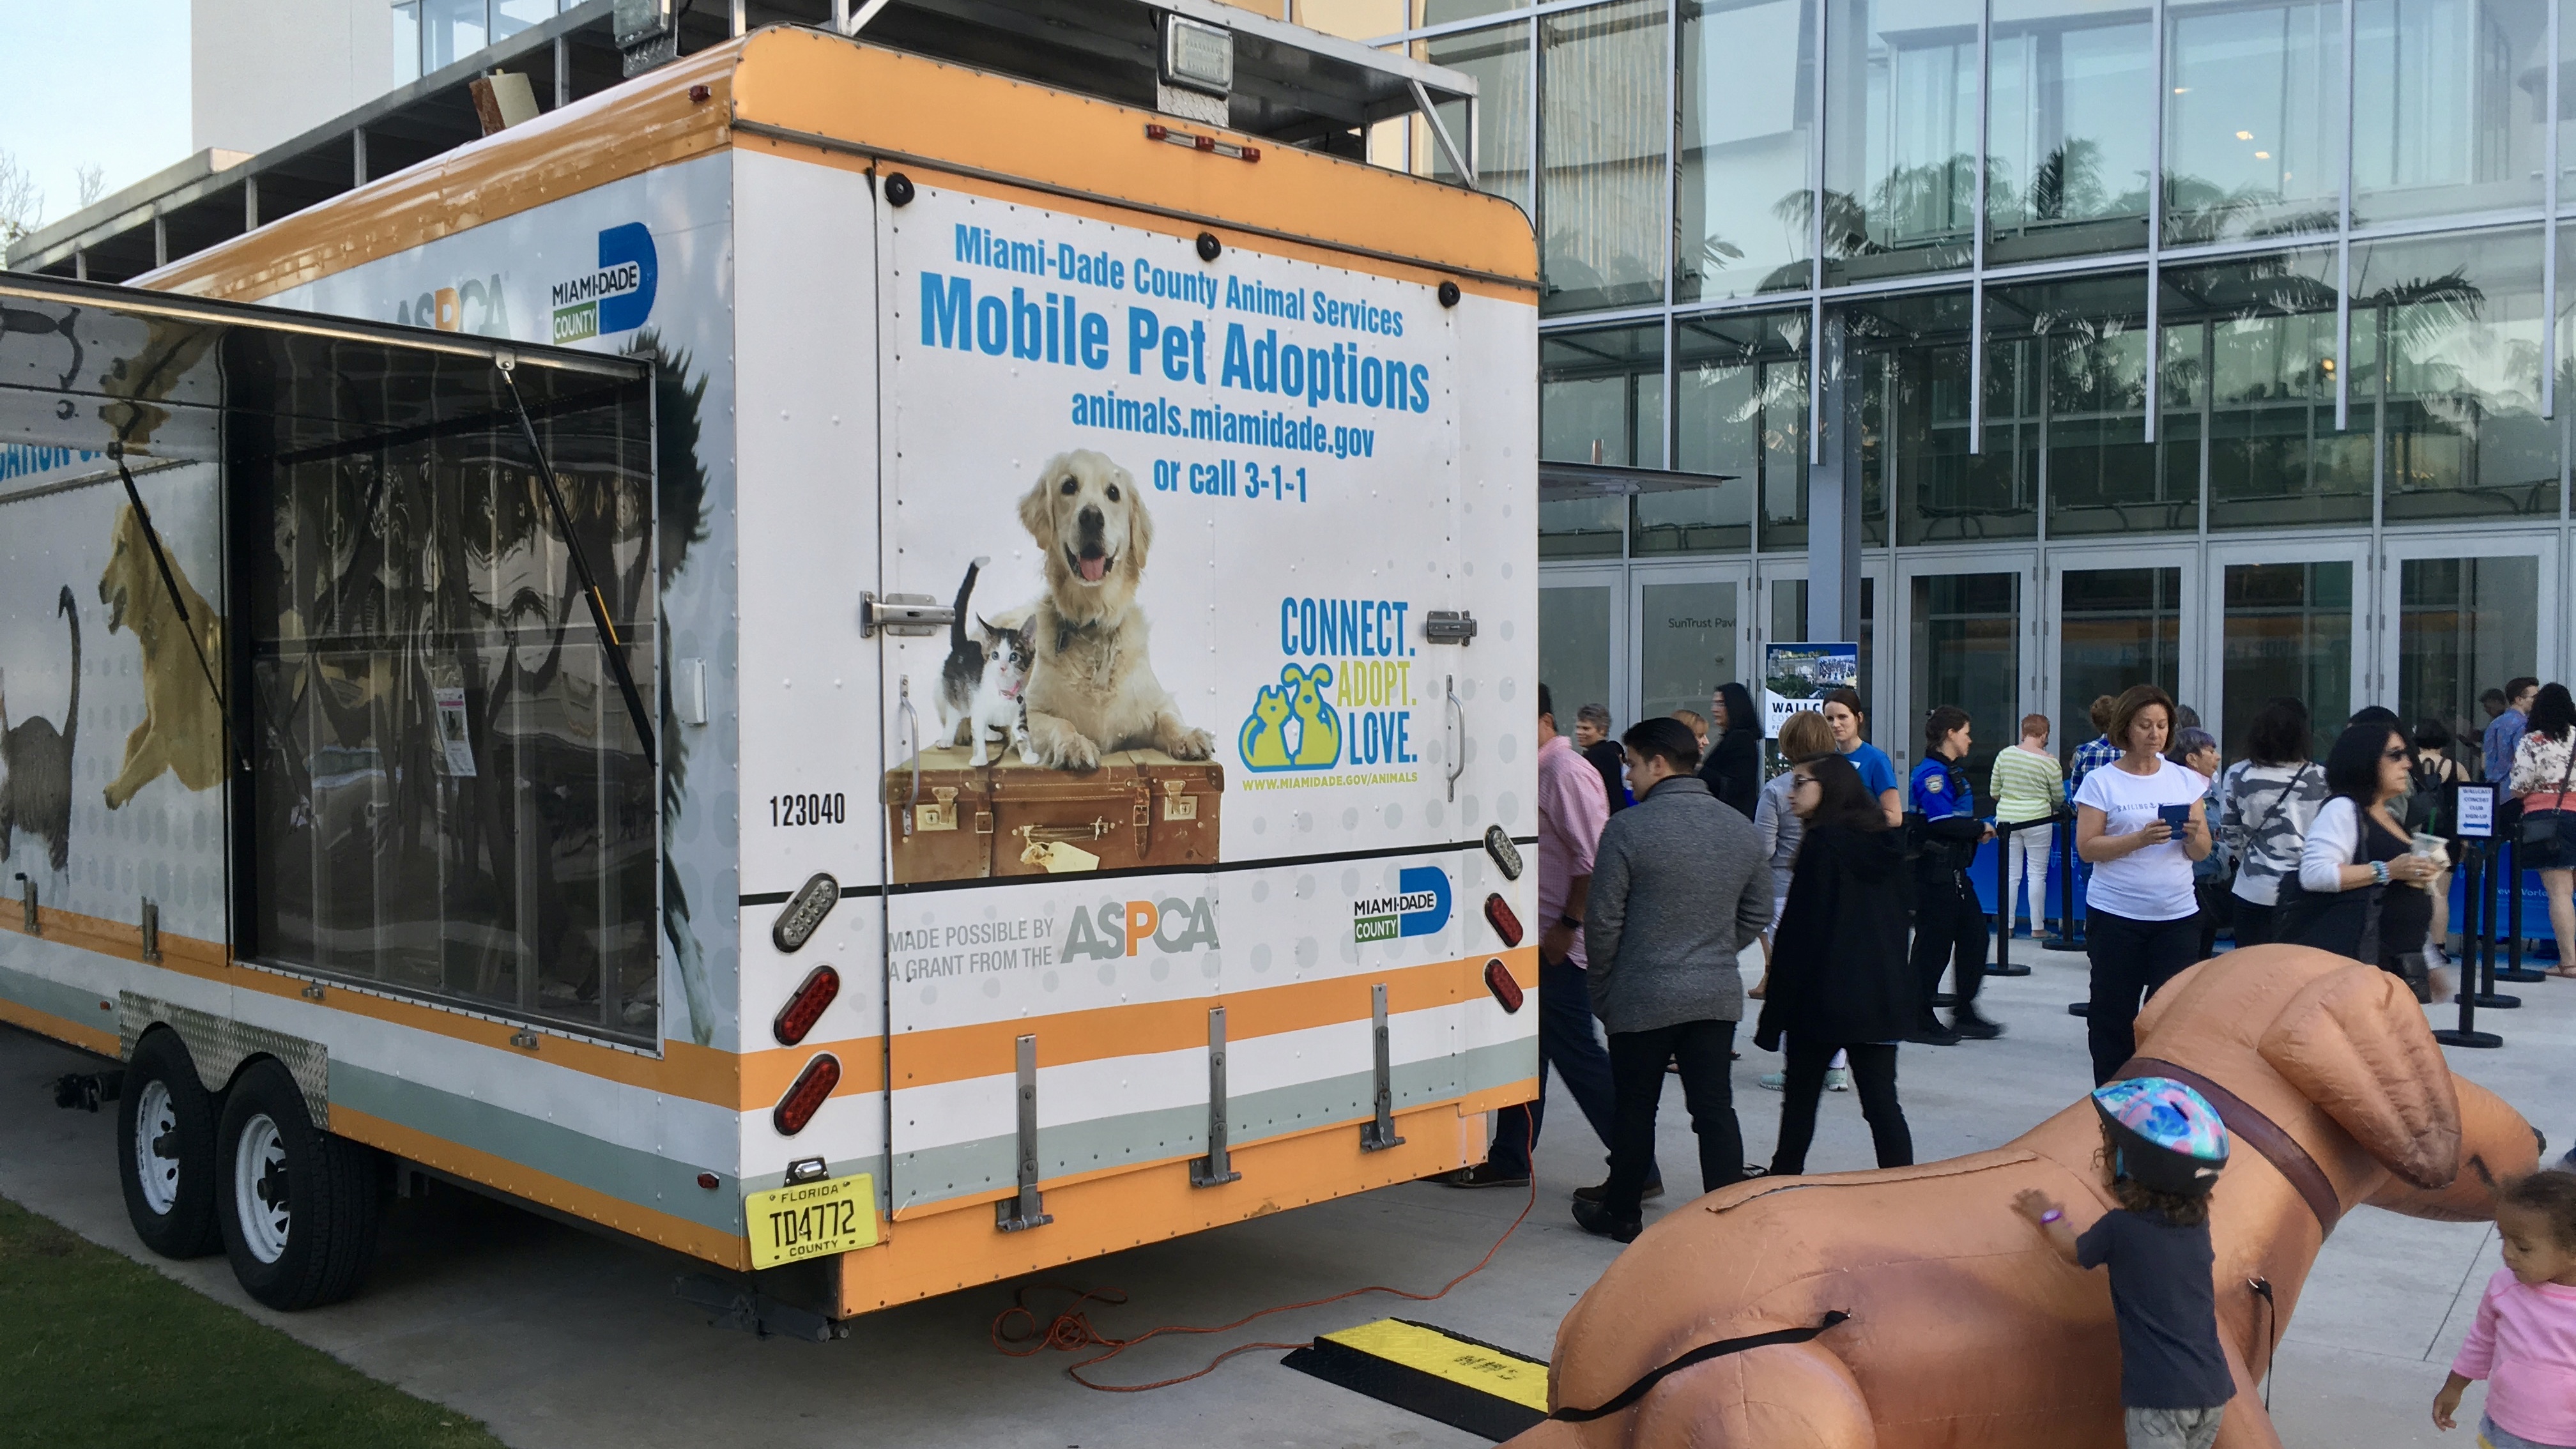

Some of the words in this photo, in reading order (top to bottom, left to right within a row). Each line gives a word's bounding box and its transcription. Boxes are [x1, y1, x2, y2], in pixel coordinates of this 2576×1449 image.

[955, 223, 1124, 290] Miami-Dade
[1134, 257, 1218, 310] County
[1226, 275, 1305, 321] Animal
[1312, 290, 1404, 337] Services
[555, 308, 595, 339] COUNTY
[920, 270, 1109, 371] Mobile
[1129, 305, 1206, 385] Pet
[1221, 321, 1430, 414] Adoptions
[1071, 389, 1374, 459] animals.miamidade.gov
[1154, 459, 1181, 491] or
[1190, 459, 1236, 497] call
[1245, 462, 1307, 503] 3-1-1
[1282, 597, 1416, 657] CONNECT.
[1668, 618, 1712, 628] SunTrust
[1337, 660, 1417, 707] ADOPT.
[1349, 712, 1418, 765] LOVE.
[1243, 771, 1418, 791] WWW.MIAMIDADE.GOV/ANIMALS
[770, 792, 845, 827] 123040
[2117, 803, 2149, 812] SAILING
[888, 928, 939, 953] MADE
[946, 920, 1028, 947] POSSIBLE
[1034, 917, 1054, 939] BY
[1061, 896, 1222, 964] ASPCA
[1356, 919, 1397, 939] COUNTY
[889, 961, 900, 981] A
[906, 954, 964, 980] GRANT
[970, 949, 1017, 973] FROM
[1022, 946, 1052, 967] THE
[781, 1184, 839, 1203] FLORIDA
[769, 1199, 856, 1248] TD4772
[789, 1239, 839, 1257] COUNTY
